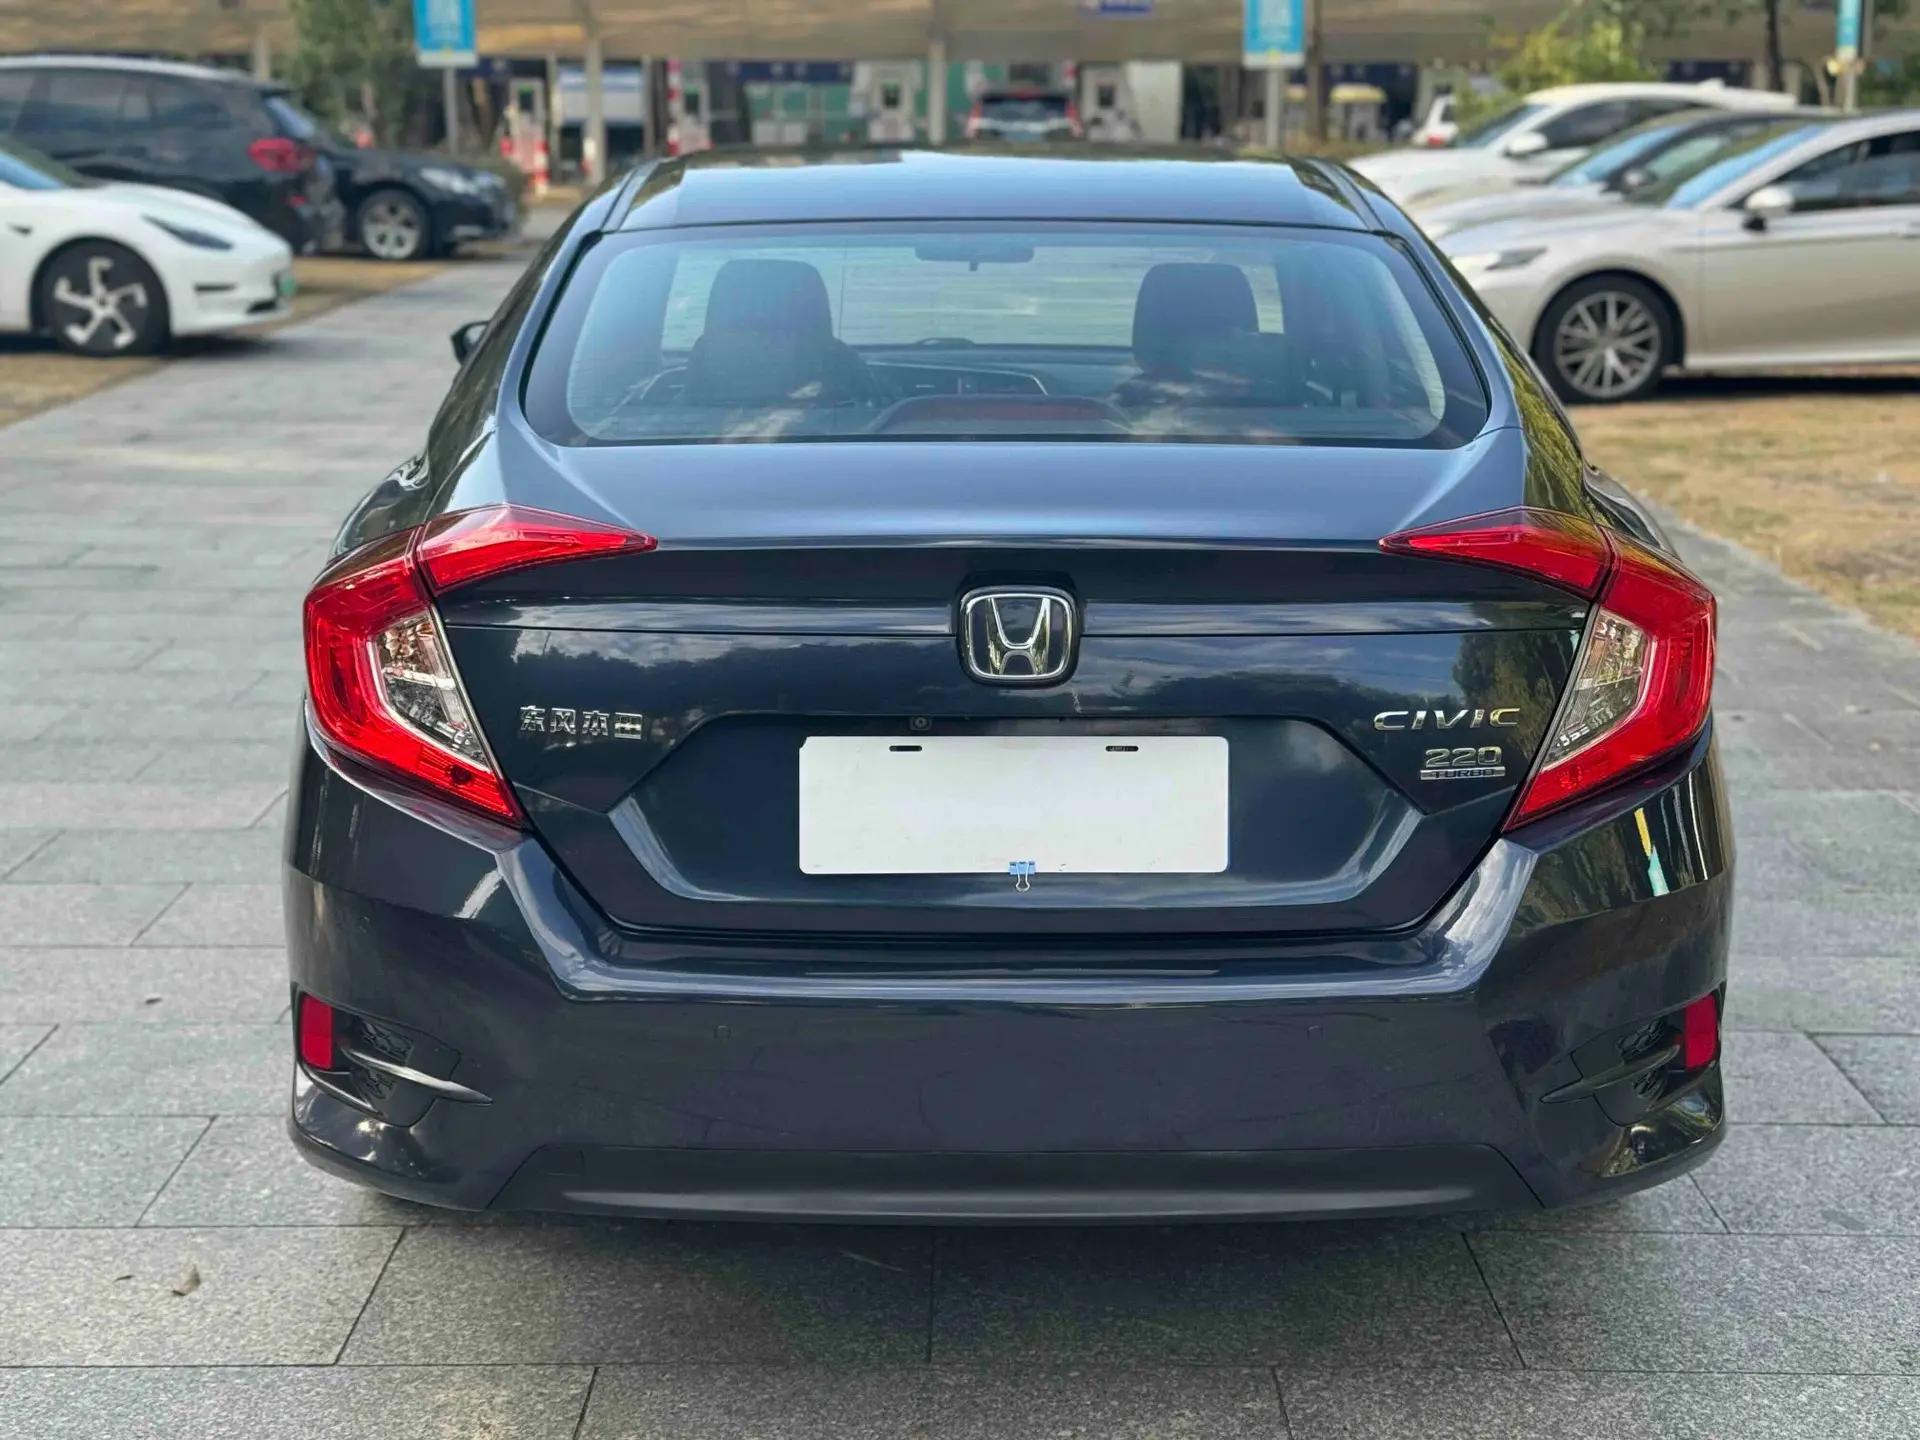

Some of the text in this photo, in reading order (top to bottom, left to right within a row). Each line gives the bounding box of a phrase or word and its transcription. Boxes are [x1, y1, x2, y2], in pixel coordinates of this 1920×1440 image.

[520, 705, 643, 740] 东风本田
[1373, 708, 1520, 731] CIVIC
[1425, 746, 1502, 768] 220
[1431, 768, 1495, 779] TURBO
